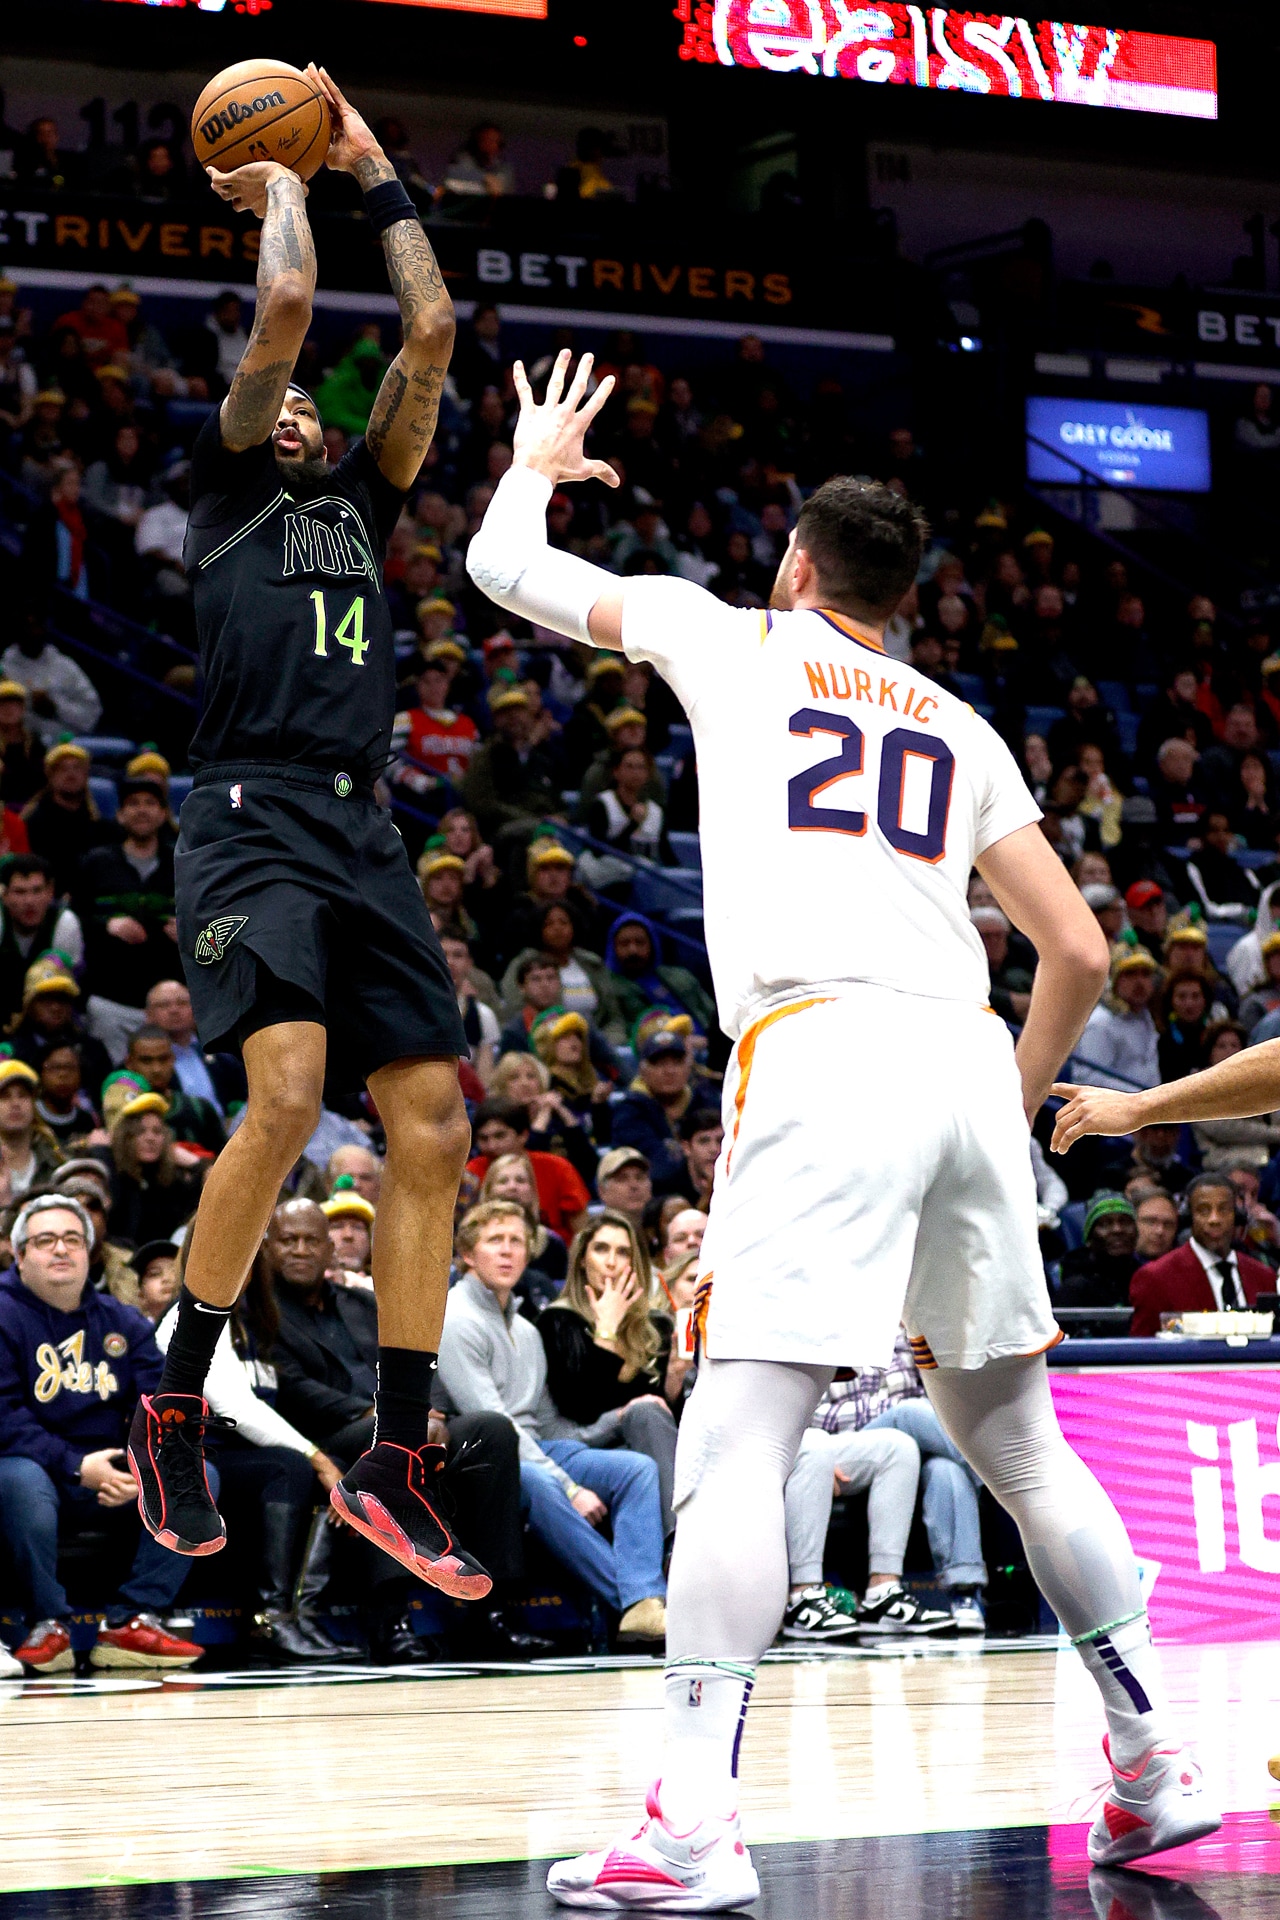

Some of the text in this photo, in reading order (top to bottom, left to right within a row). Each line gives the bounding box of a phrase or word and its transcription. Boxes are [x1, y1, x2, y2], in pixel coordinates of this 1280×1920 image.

[200, 90, 287, 145] Wilson
[475, 247, 795, 306] BETRIVERS
[308, 588, 371, 667] 14
[803, 661, 939, 724] NURKIĆ
[788, 707, 956, 866] 20
